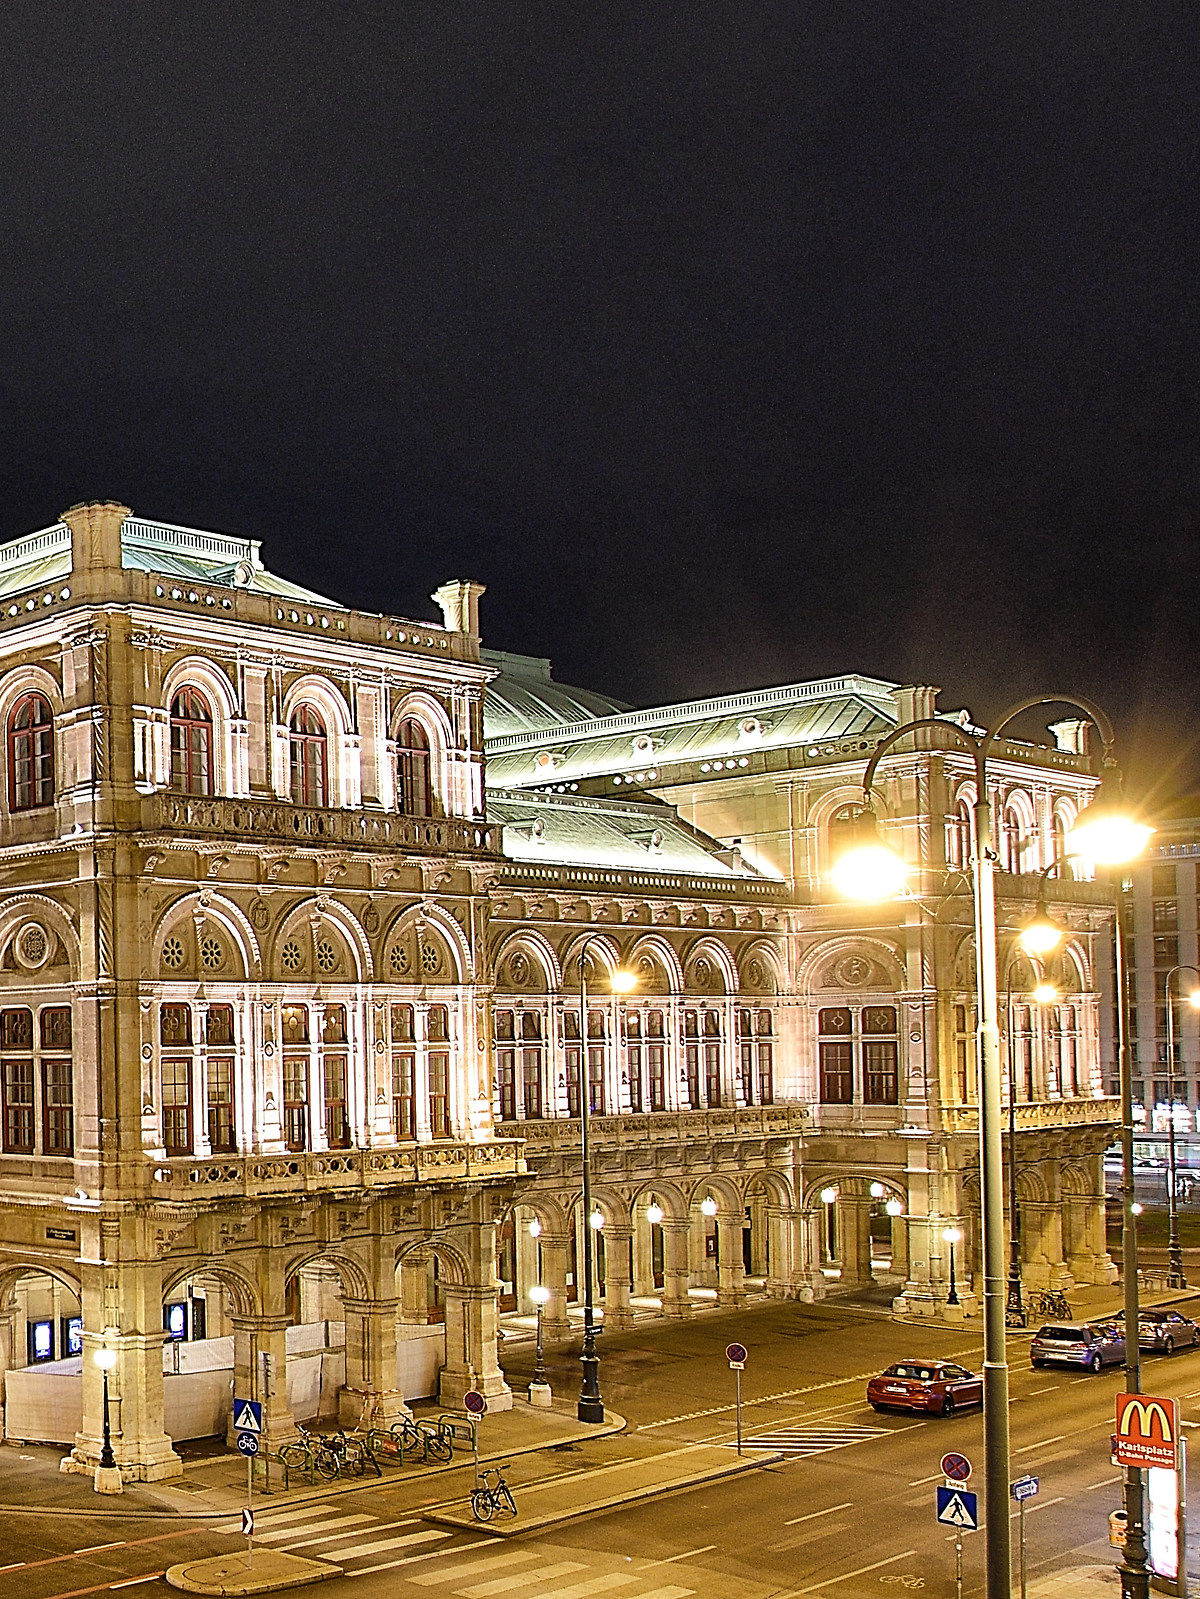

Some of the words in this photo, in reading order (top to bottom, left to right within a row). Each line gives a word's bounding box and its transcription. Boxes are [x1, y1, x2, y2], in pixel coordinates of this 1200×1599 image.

[1118, 1440, 1174, 1457] Karlsplatz
[1118, 1450, 1144, 1460] U-Bahn
[1144, 1454, 1174, 1465] Passage
